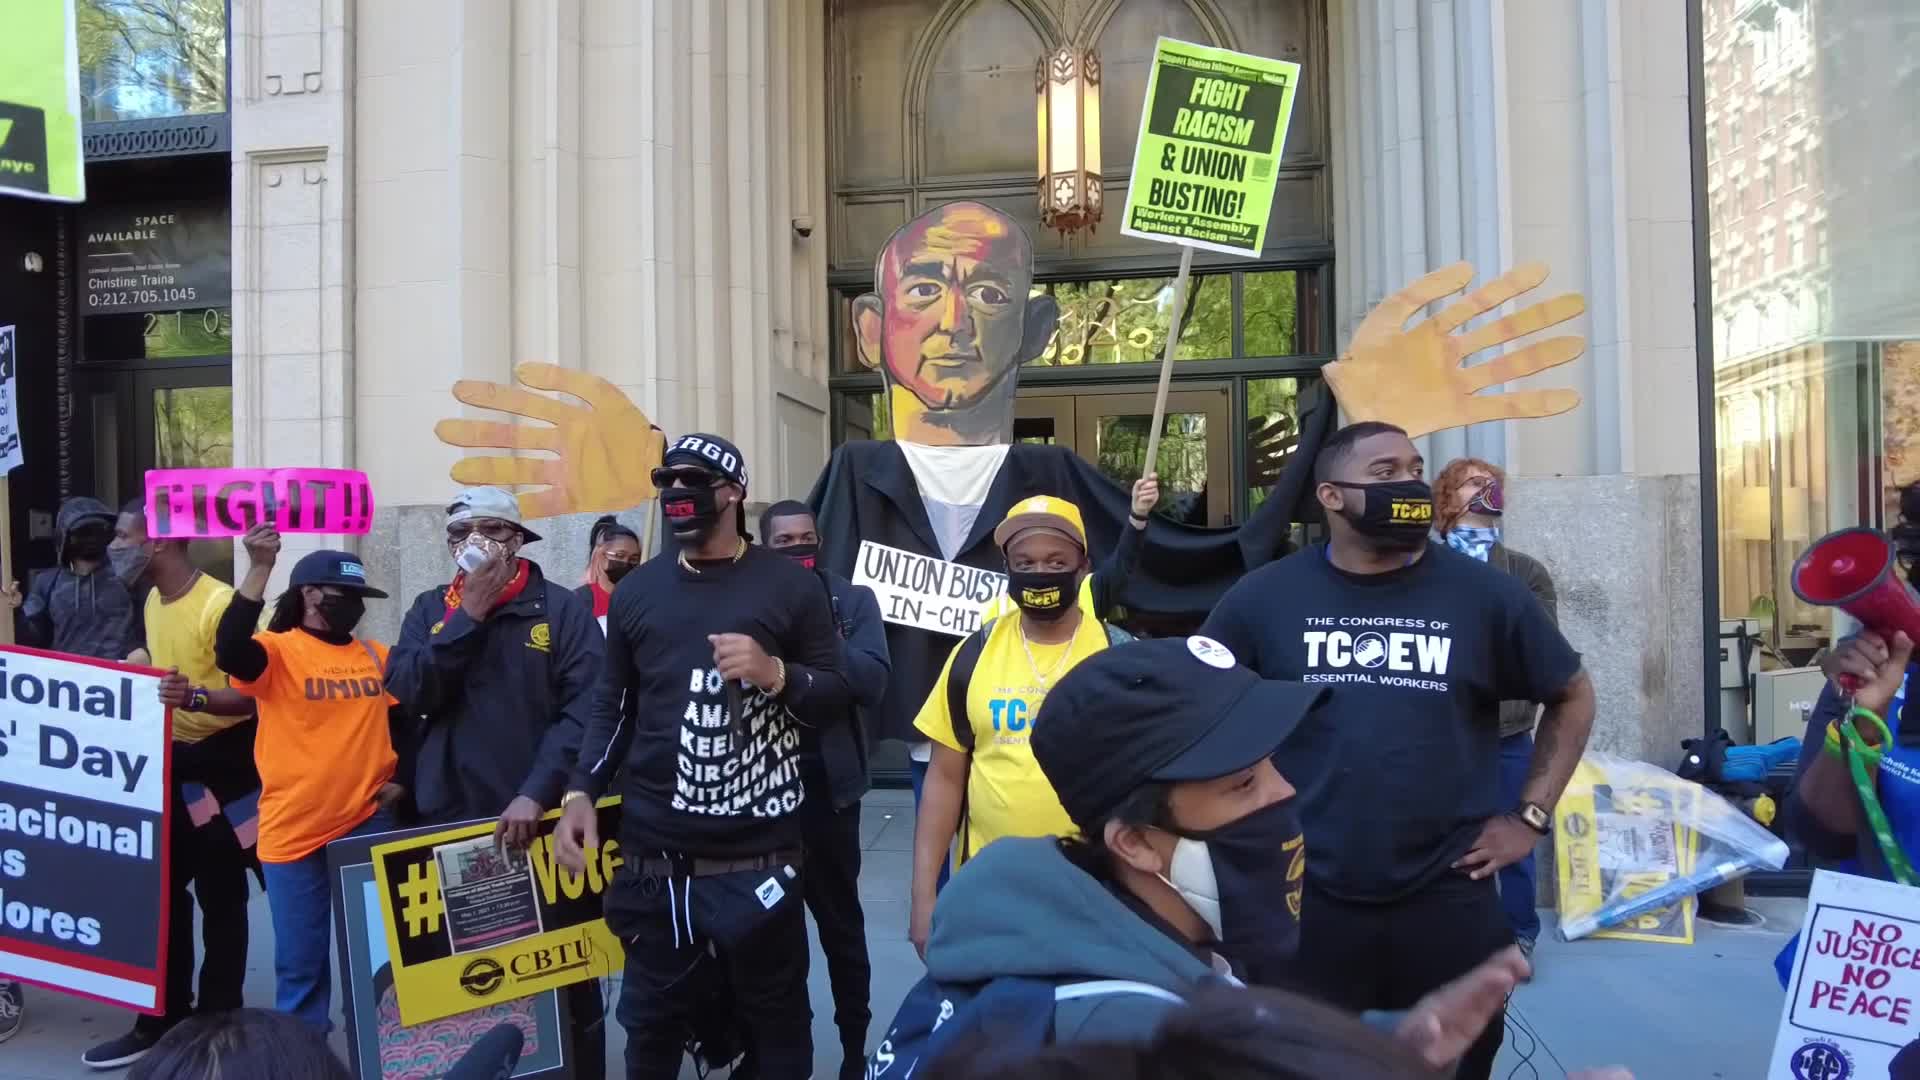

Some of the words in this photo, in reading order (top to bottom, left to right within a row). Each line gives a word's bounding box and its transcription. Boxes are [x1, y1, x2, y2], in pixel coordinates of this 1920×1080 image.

[1189, 77, 1250, 112] FIGHT
[1173, 108, 1255, 146] RACISM
[1161, 143, 1176, 171] &
[1181, 146, 1247, 183] UNION
[1150, 178, 1246, 219] BUSTING!
[87, 230, 157, 243] AVAILABLE
[135, 215, 175, 226] SPACE
[1133, 218, 1186, 235] Against
[1183, 226, 1228, 242] Racism
[1136, 207, 1188, 224] Workers
[1191, 215, 1251, 236] Assembly
[88, 277, 137, 289] Christine
[141, 275, 175, 286] Traina
[155, 479, 369, 535] FIGHT!!
[864, 543, 948, 596] UNION
[948, 567, 1009, 604] BUST
[1305, 617, 1335, 626] THE
[1339, 617, 1425, 628] CONGRESS
[1430, 620, 1451, 631] OF
[1303, 674, 1376, 684] ESSENTIAL
[1379, 675, 1448, 692] WORKERS
[39, 724, 149, 793] Day
[680, 725, 735, 758] KEE
[675, 754, 766, 801] WITHIN
[1852, 919, 1903, 943] NO
[510, 937, 593, 976] CBTU
[1840, 963, 1891, 990] NO
[1809, 980, 1912, 1026] PEACE
